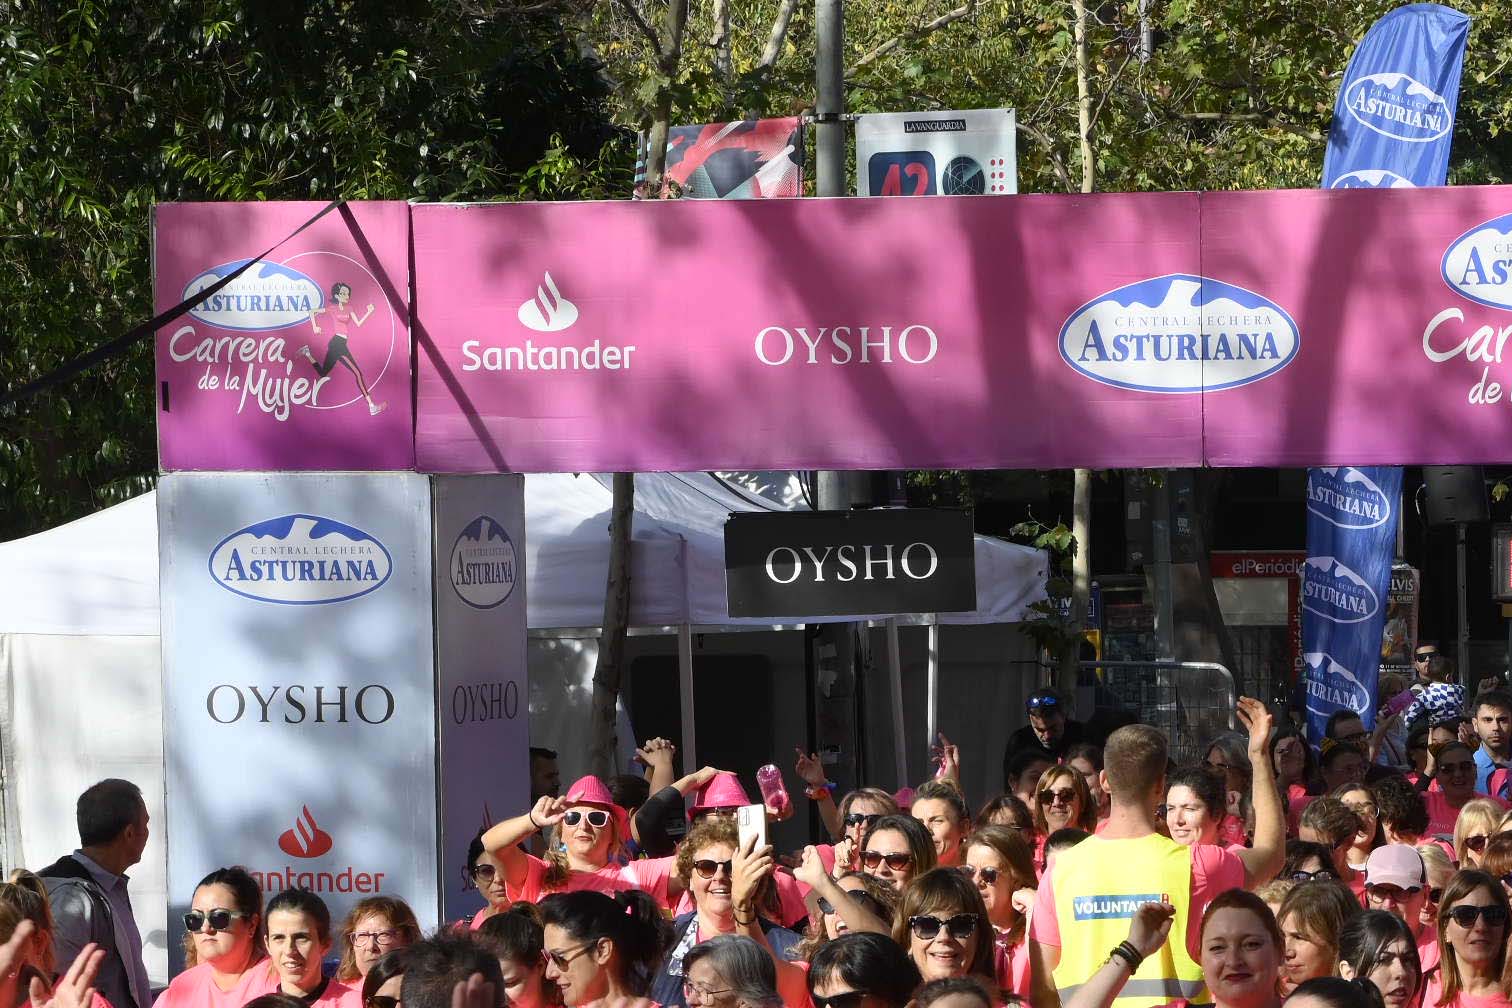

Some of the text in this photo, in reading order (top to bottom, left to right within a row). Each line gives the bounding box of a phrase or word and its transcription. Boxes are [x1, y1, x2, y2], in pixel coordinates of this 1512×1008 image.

[1352, 87, 1442, 132] ASTURIANA
[1078, 319, 1281, 361] ASTURIANA
[1114, 316, 1191, 327] CENTRAL
[169, 325, 287, 364] Carrera
[461, 339, 636, 371] Santander
[754, 325, 938, 365] OYSHO
[198, 359, 331, 422] de la Mujer
[1468, 367, 1503, 405] de
[223, 548, 380, 582] ASTURIANA
[250, 545, 373, 555] CENTRAL LECHERA
[455, 551, 513, 586] ASTURIANA
[765, 542, 939, 585] OYSHO
[206, 684, 396, 724] OYSHO
[453, 680, 519, 724] OYSHO
[251, 866, 385, 893] antander
